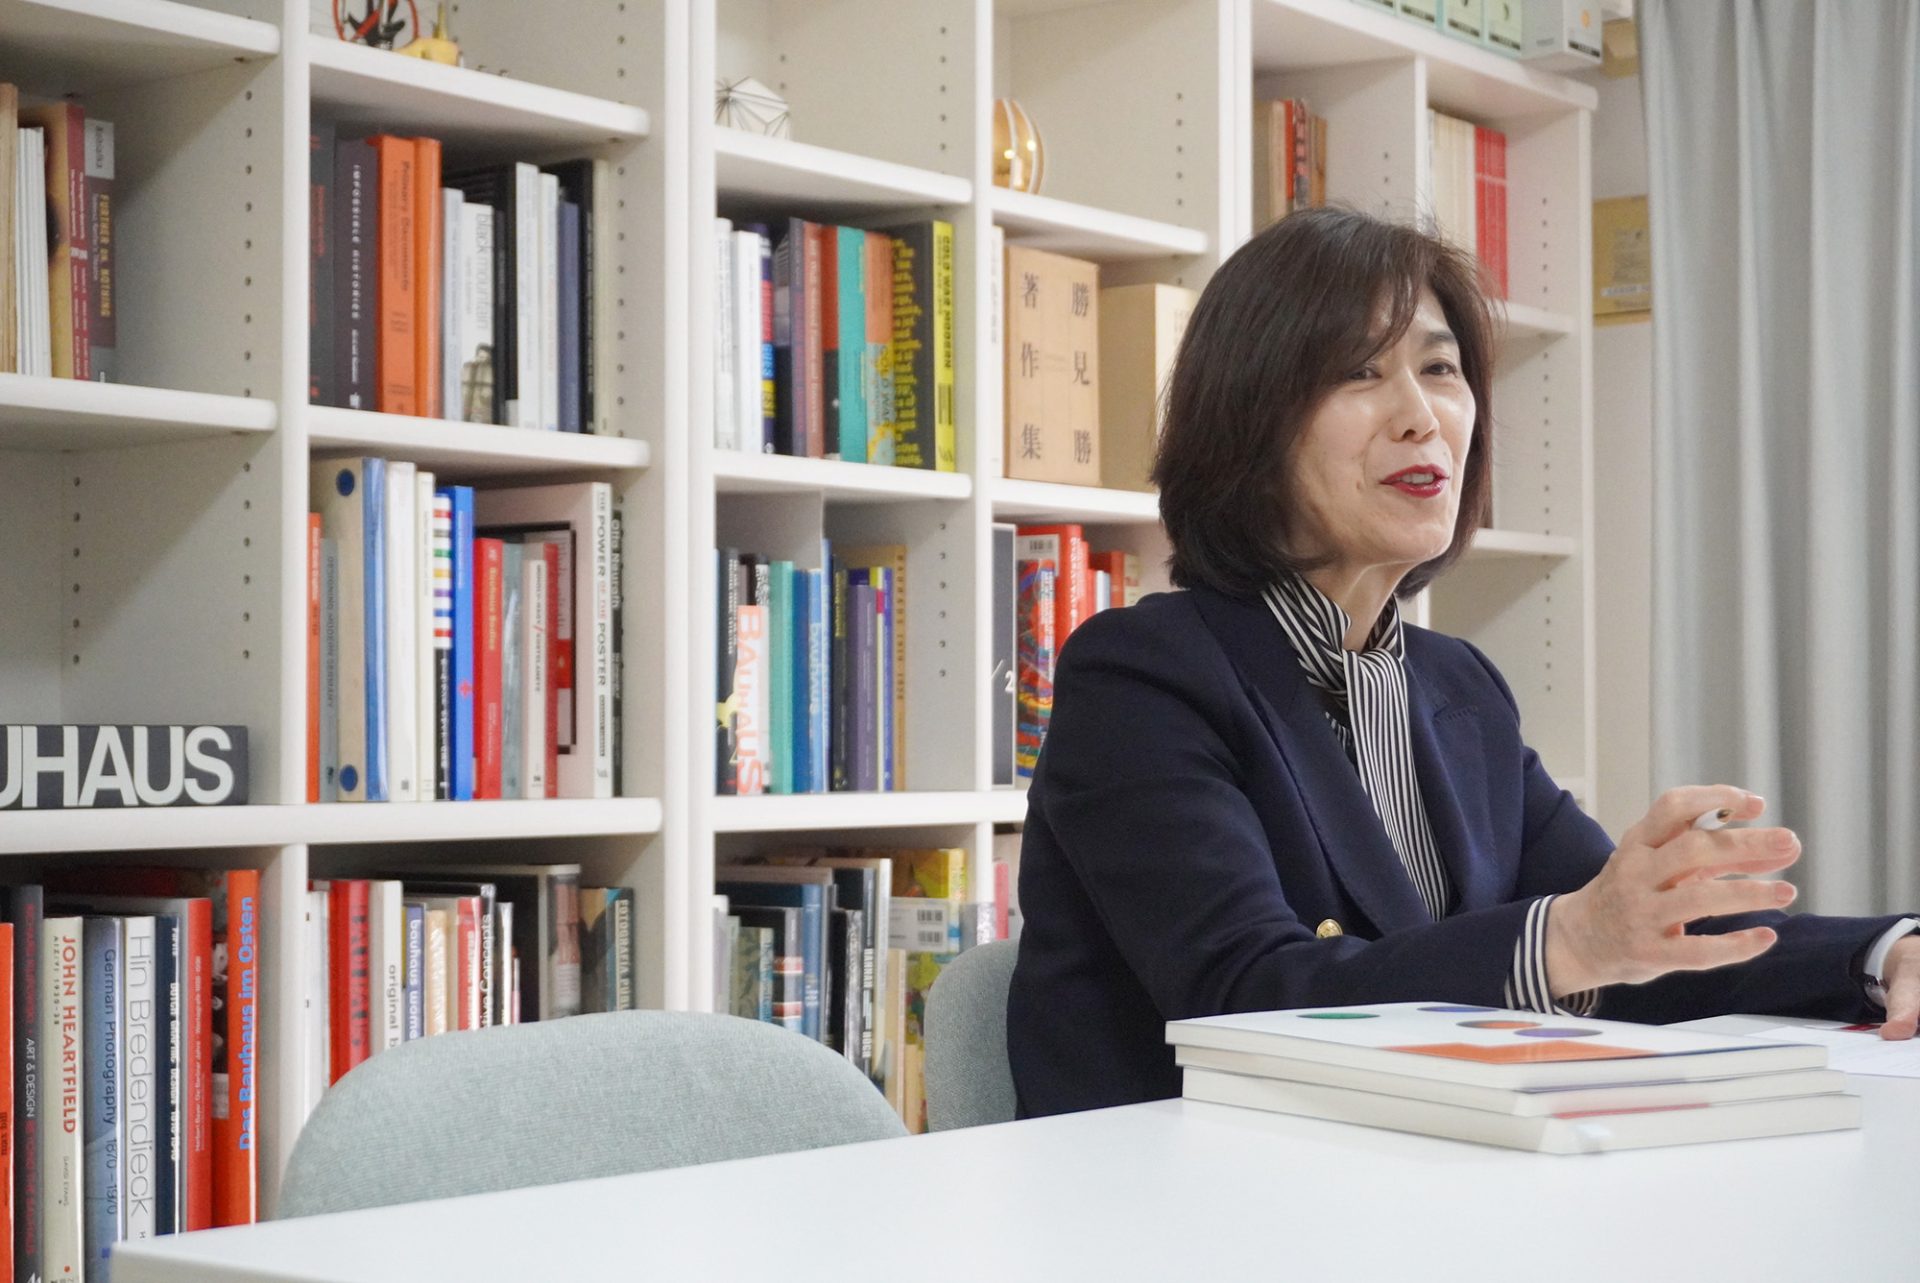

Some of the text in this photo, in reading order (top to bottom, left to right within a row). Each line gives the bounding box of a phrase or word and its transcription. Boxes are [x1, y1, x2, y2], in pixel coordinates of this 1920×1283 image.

[475, 213, 492, 330] black mountain
[942, 310, 952, 368] MODERN
[1020, 271, 1042, 461] 著作集
[1071, 281, 1092, 465] 勝見勝
[597, 515, 606, 577] POWER
[326, 556, 335, 708] DESIGNING MODERN GERMANY
[489, 567, 497, 650] Bauhaus Bodies
[597, 622, 606, 686] POSTER
[736, 605, 764, 795] BAUHAUS
[103, 949, 116, 1015] German
[130, 935, 151, 987] Hin
[409, 919, 421, 985] bauhaus
[479, 914, 492, 992] Concepts
[863, 948, 873, 989] HANNAH
[238, 896, 253, 1150] Das Bauhaus im Osten
[386, 964, 399, 1030] original
[26, 1038, 35, 1059] ART
[26, 1062, 35, 1072] &
[62, 935, 76, 1134] JOHN HEARTFIELD
[26, 1074, 35, 1118] DESIGN
[98, 1021, 116, 1125] Photography
[130, 999, 152, 1217] Bredendieck
